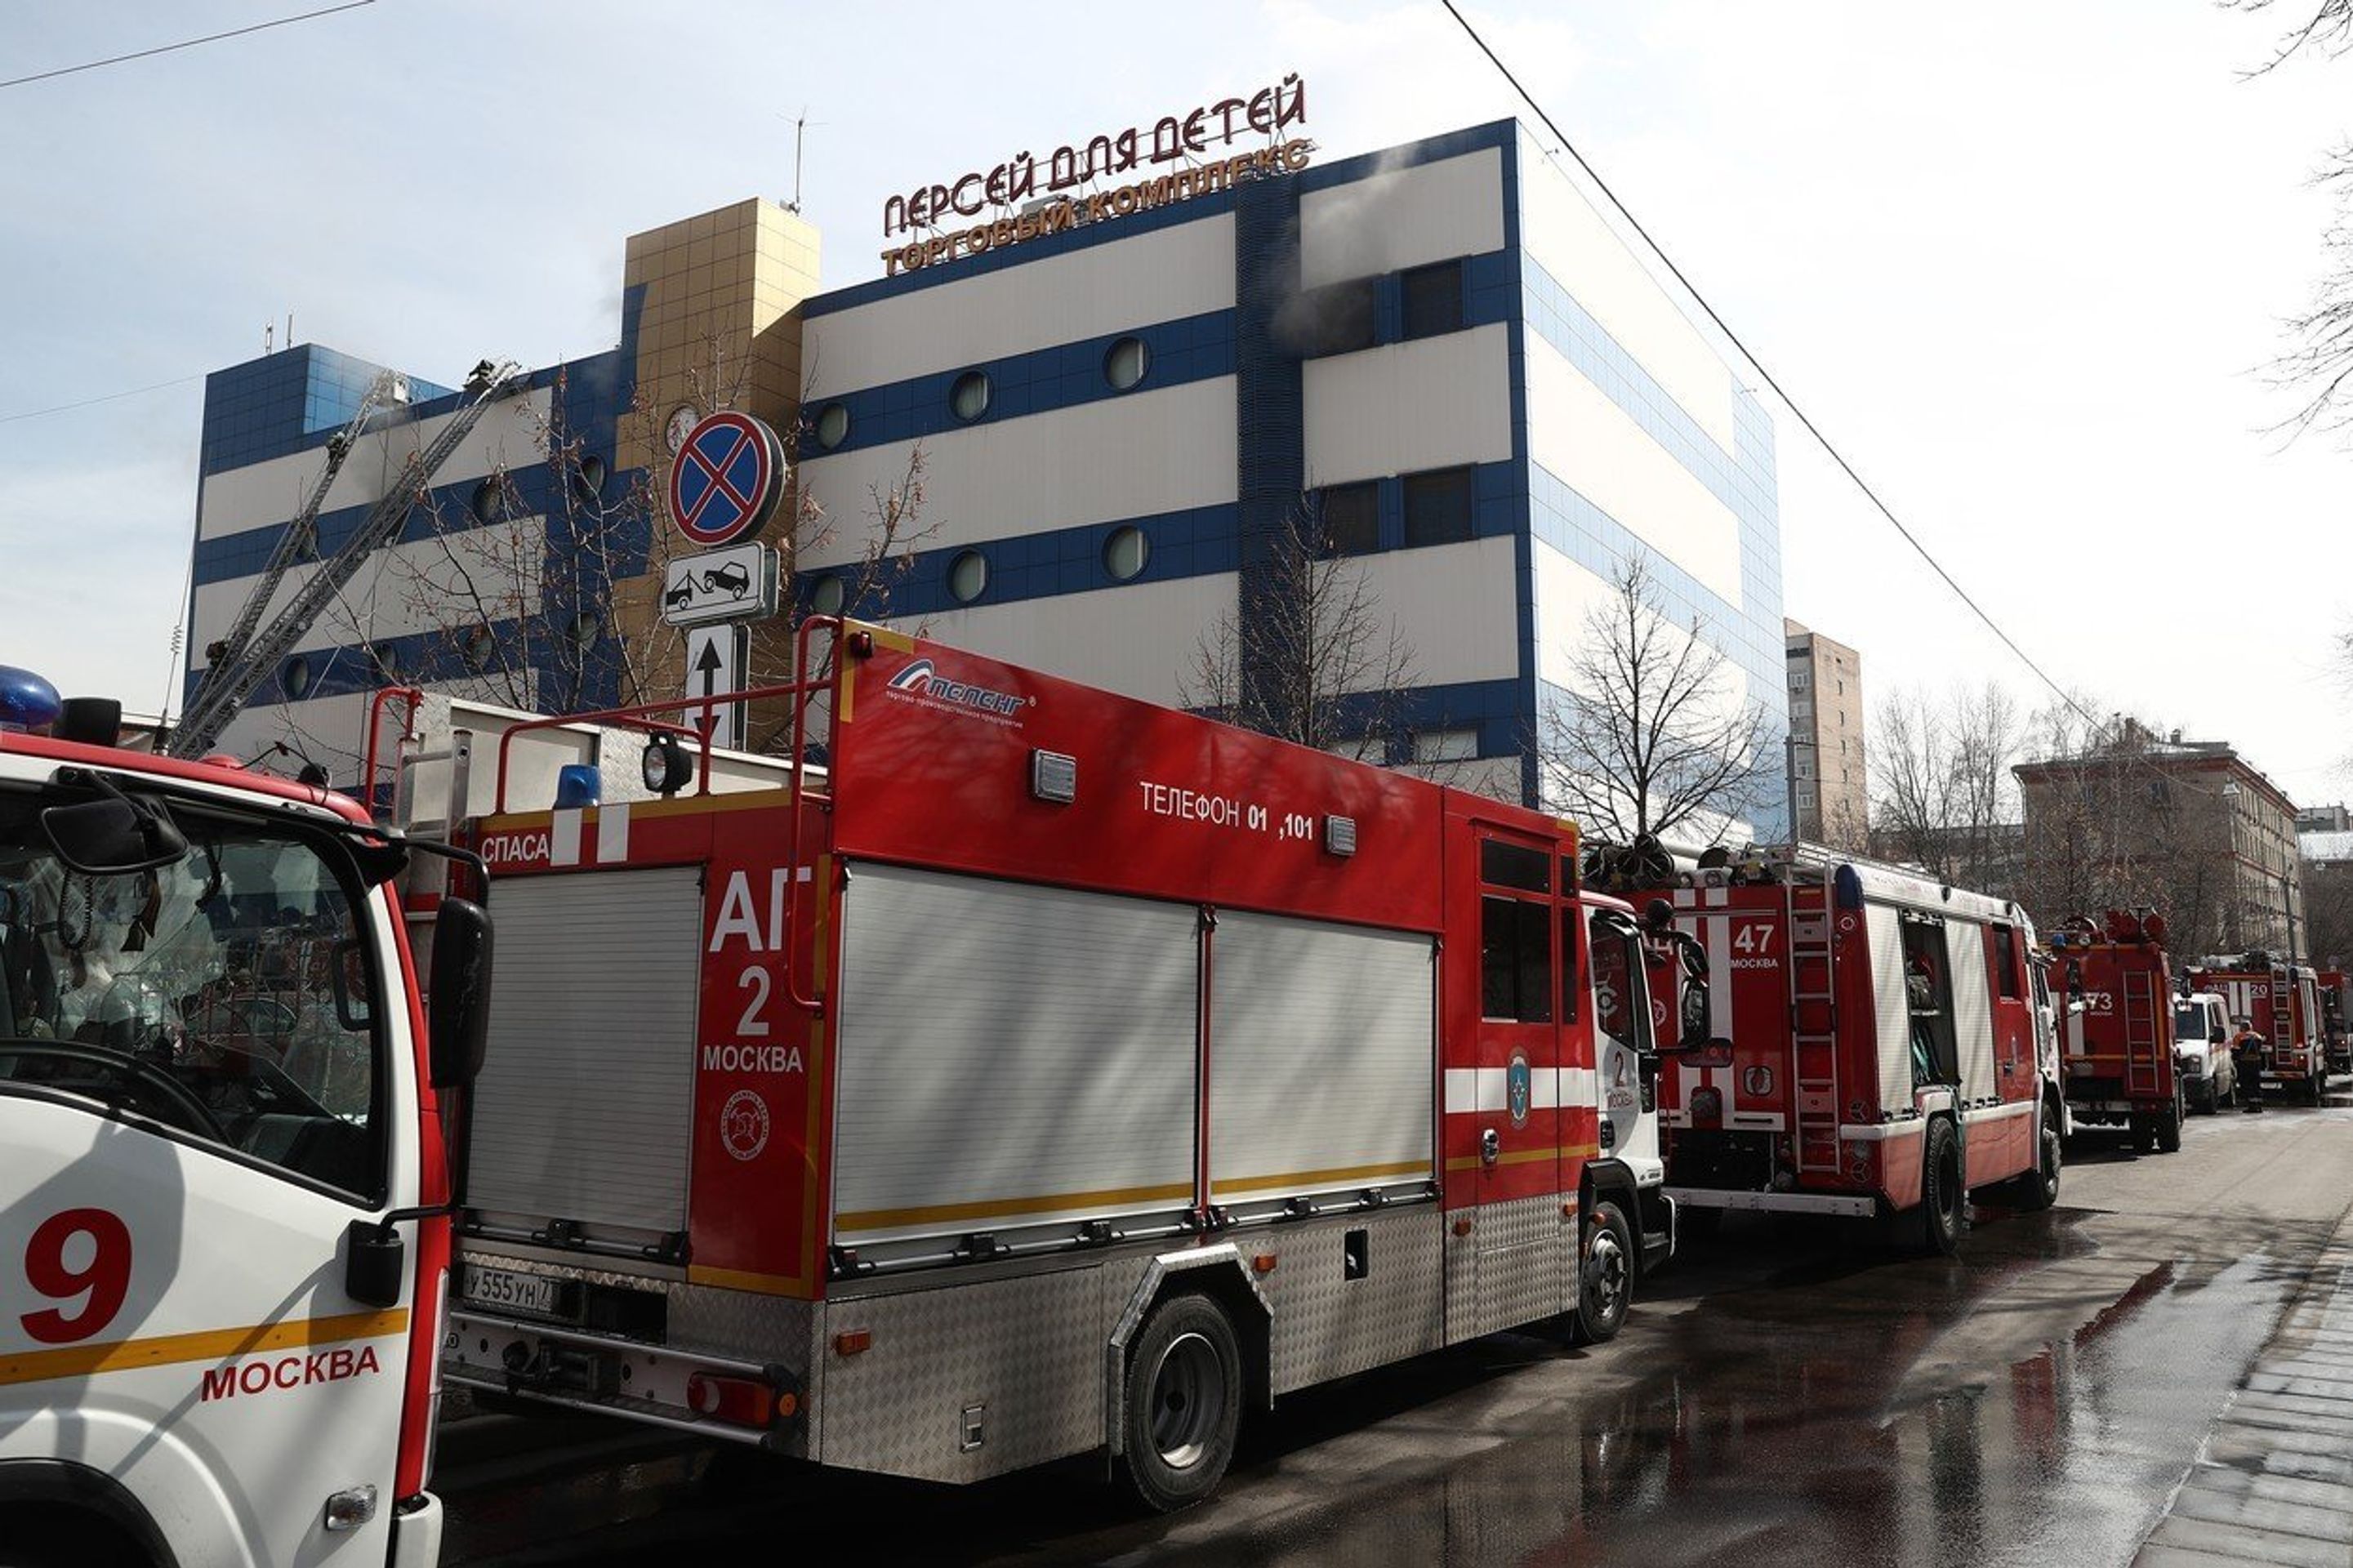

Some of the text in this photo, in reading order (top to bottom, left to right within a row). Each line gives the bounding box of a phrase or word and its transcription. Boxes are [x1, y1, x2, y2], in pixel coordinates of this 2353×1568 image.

[885, 72, 1307, 238] ПЕРСЕЙ ДЛЯ ДЕТЕЙ
[881, 138, 1310, 277] ТОРГОВЫЙ КОМПЛЕКС
[1140, 781, 1241, 828] ТЕЛЕФОН
[1247, 804, 1267, 831] 01
[481, 833, 550, 864] СПАСА
[709, 866, 812, 952] АГ
[1731, 958, 1779, 969] МОСКВА
[1735, 924, 1775, 954] 47
[736, 965, 771, 1036] 2
[2251, 984, 2268, 996] 20
[703, 1045, 804, 1072] МОСКВА
[1615, 1050, 1628, 1087] 2
[20, 1208, 132, 1344] 9
[201, 1346, 380, 1402] МОСКВА
